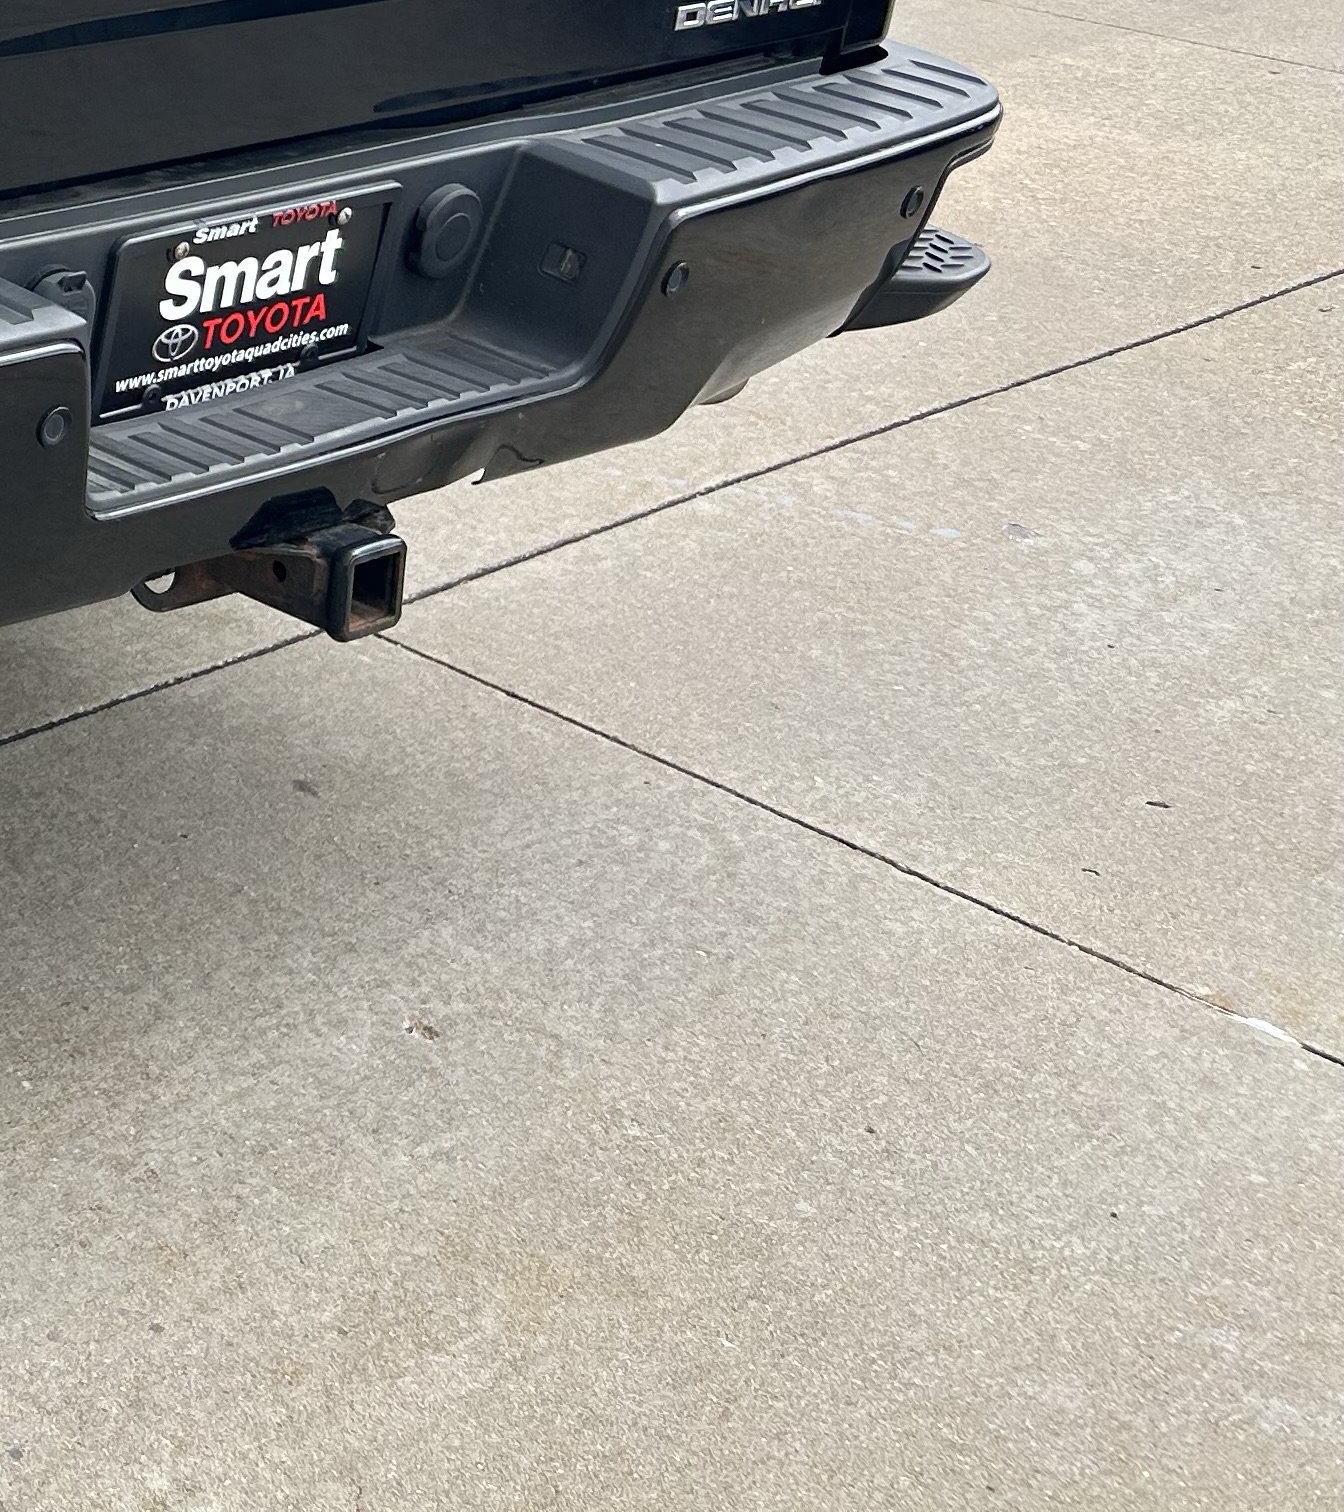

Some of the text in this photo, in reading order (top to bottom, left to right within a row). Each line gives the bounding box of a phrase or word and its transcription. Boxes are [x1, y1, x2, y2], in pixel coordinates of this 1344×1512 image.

[193, 199, 339, 245] Smart TOYOTA
[159, 228, 344, 322] Smart
[201, 293, 328, 351] TOYOTA
[114, 322, 350, 394] www.smarttoyotaquadcities.com
[278, 363, 295, 381] IA
